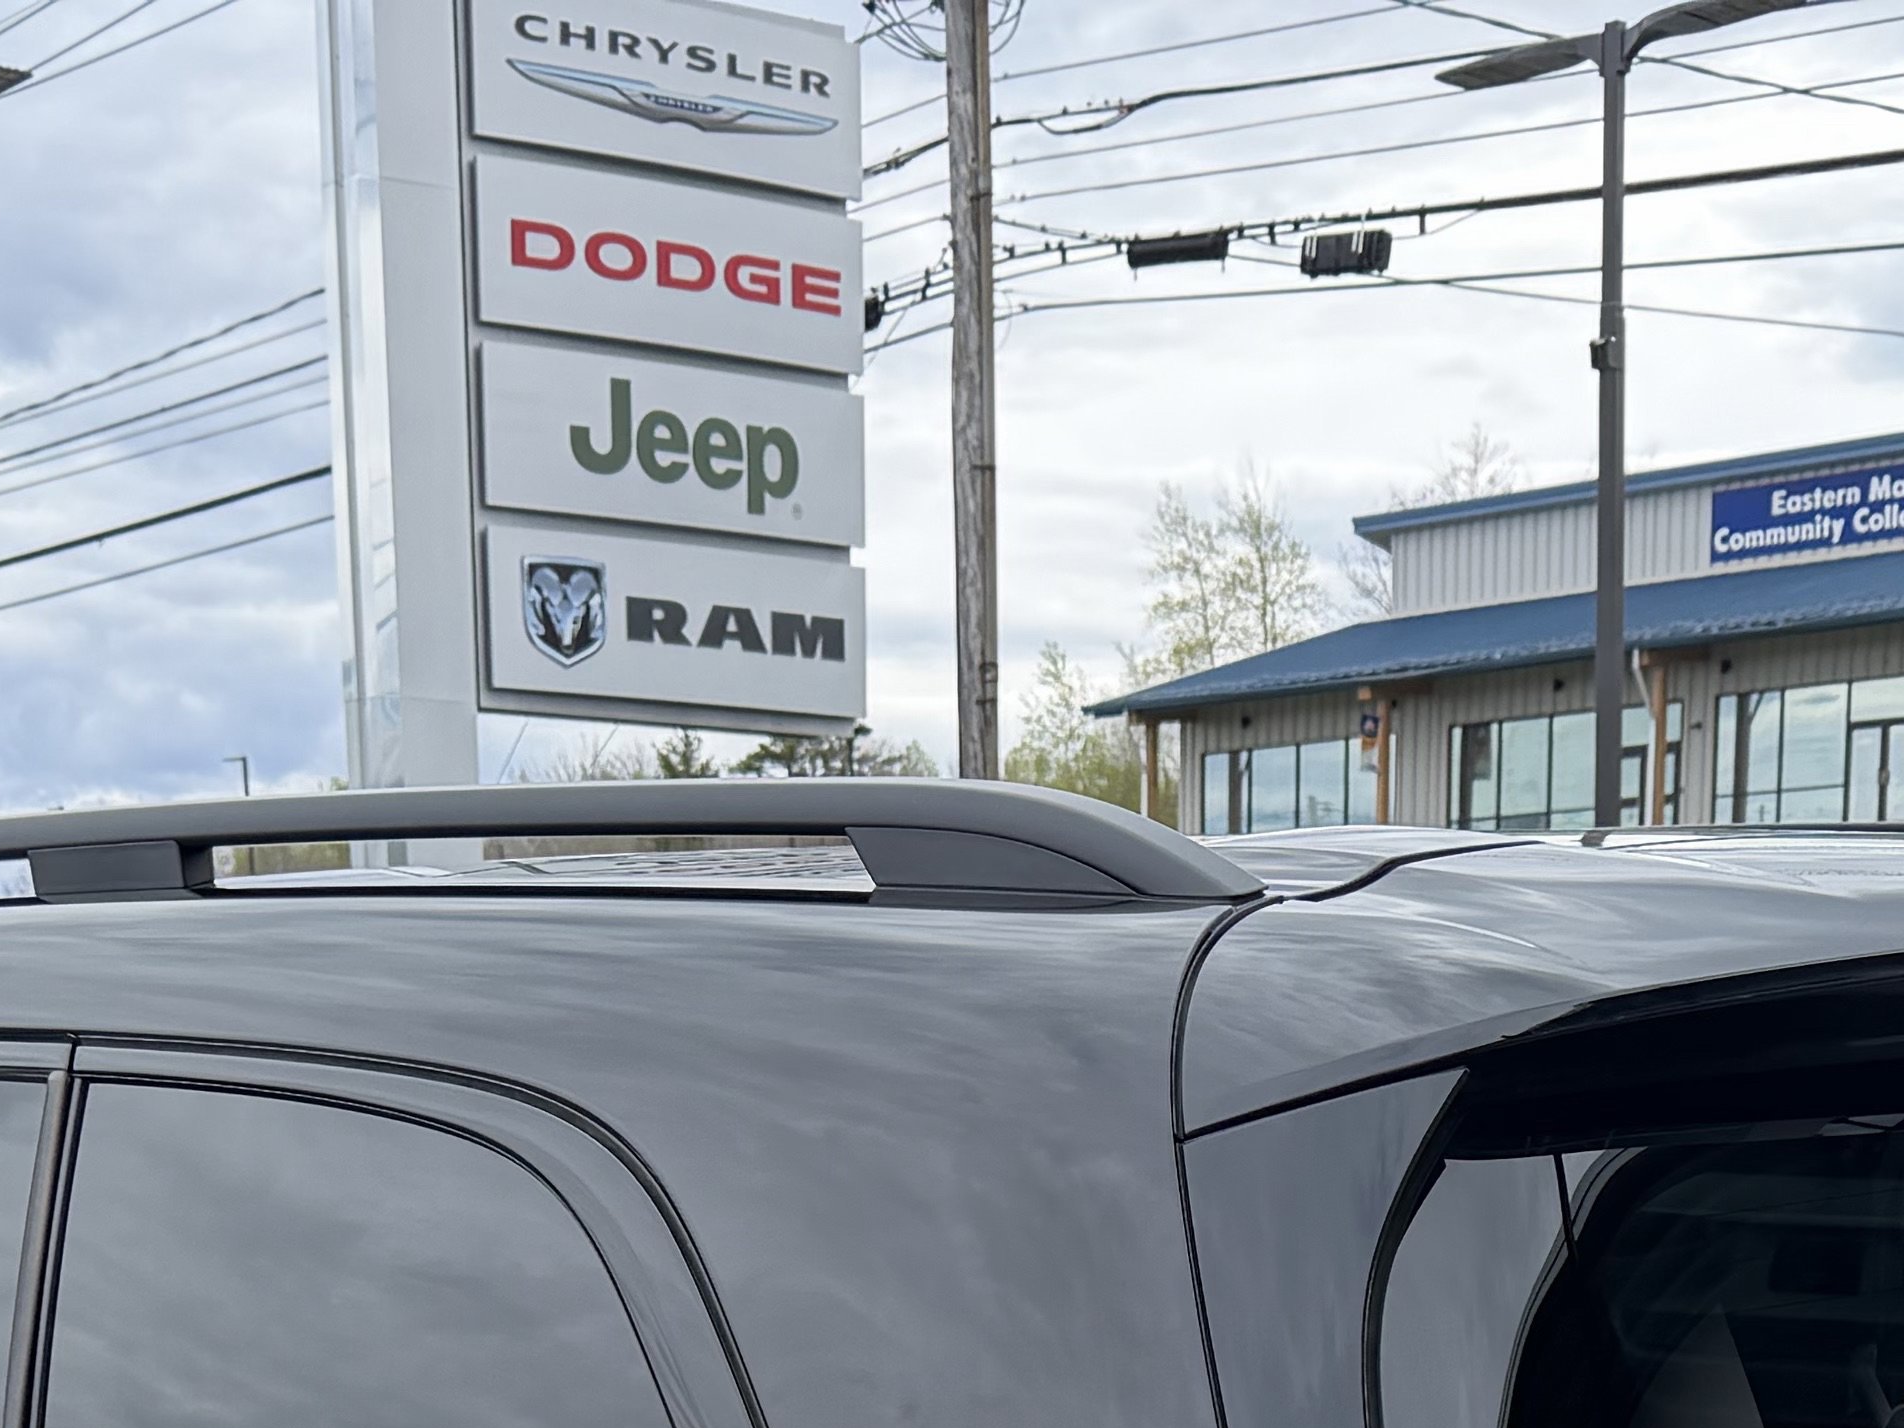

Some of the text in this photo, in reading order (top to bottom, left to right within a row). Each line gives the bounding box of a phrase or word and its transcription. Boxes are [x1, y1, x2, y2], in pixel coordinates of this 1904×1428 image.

[513, 14, 832, 98] CHRYSLER
[509, 217, 842, 317] DODGE
[569, 377, 799, 515] Jeep
[1713, 513, 1845, 554] Community
[1771, 486, 1862, 517] Eastern
[625, 595, 846, 662] RAM
